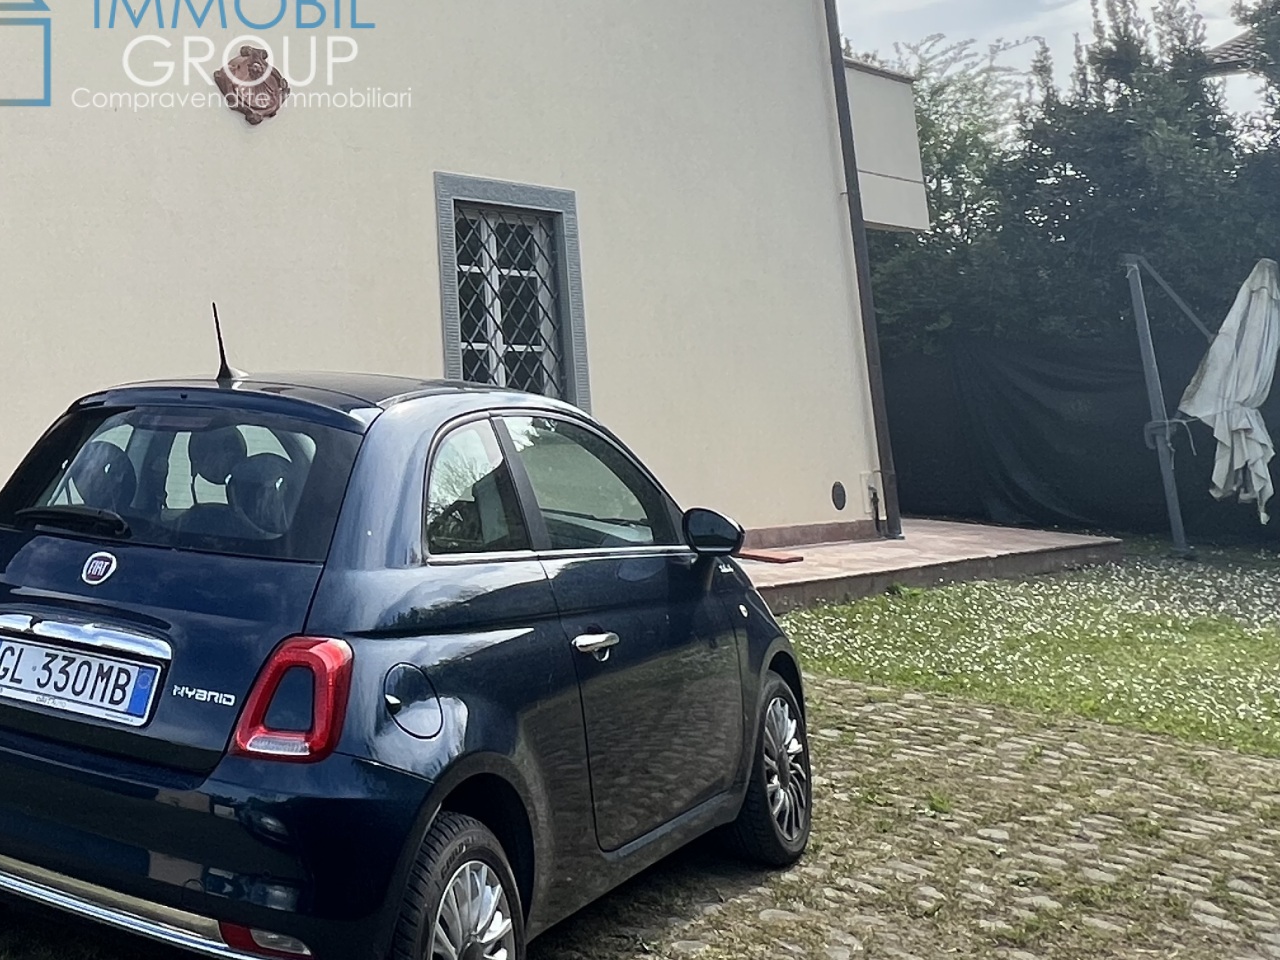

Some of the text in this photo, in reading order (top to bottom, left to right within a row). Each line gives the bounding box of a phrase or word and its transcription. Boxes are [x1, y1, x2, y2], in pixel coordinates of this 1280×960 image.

[87, 559, 111, 577] FIAT
[36, 652, 132, 707] 330MB
[172, 684, 237, 707] HYBRID
